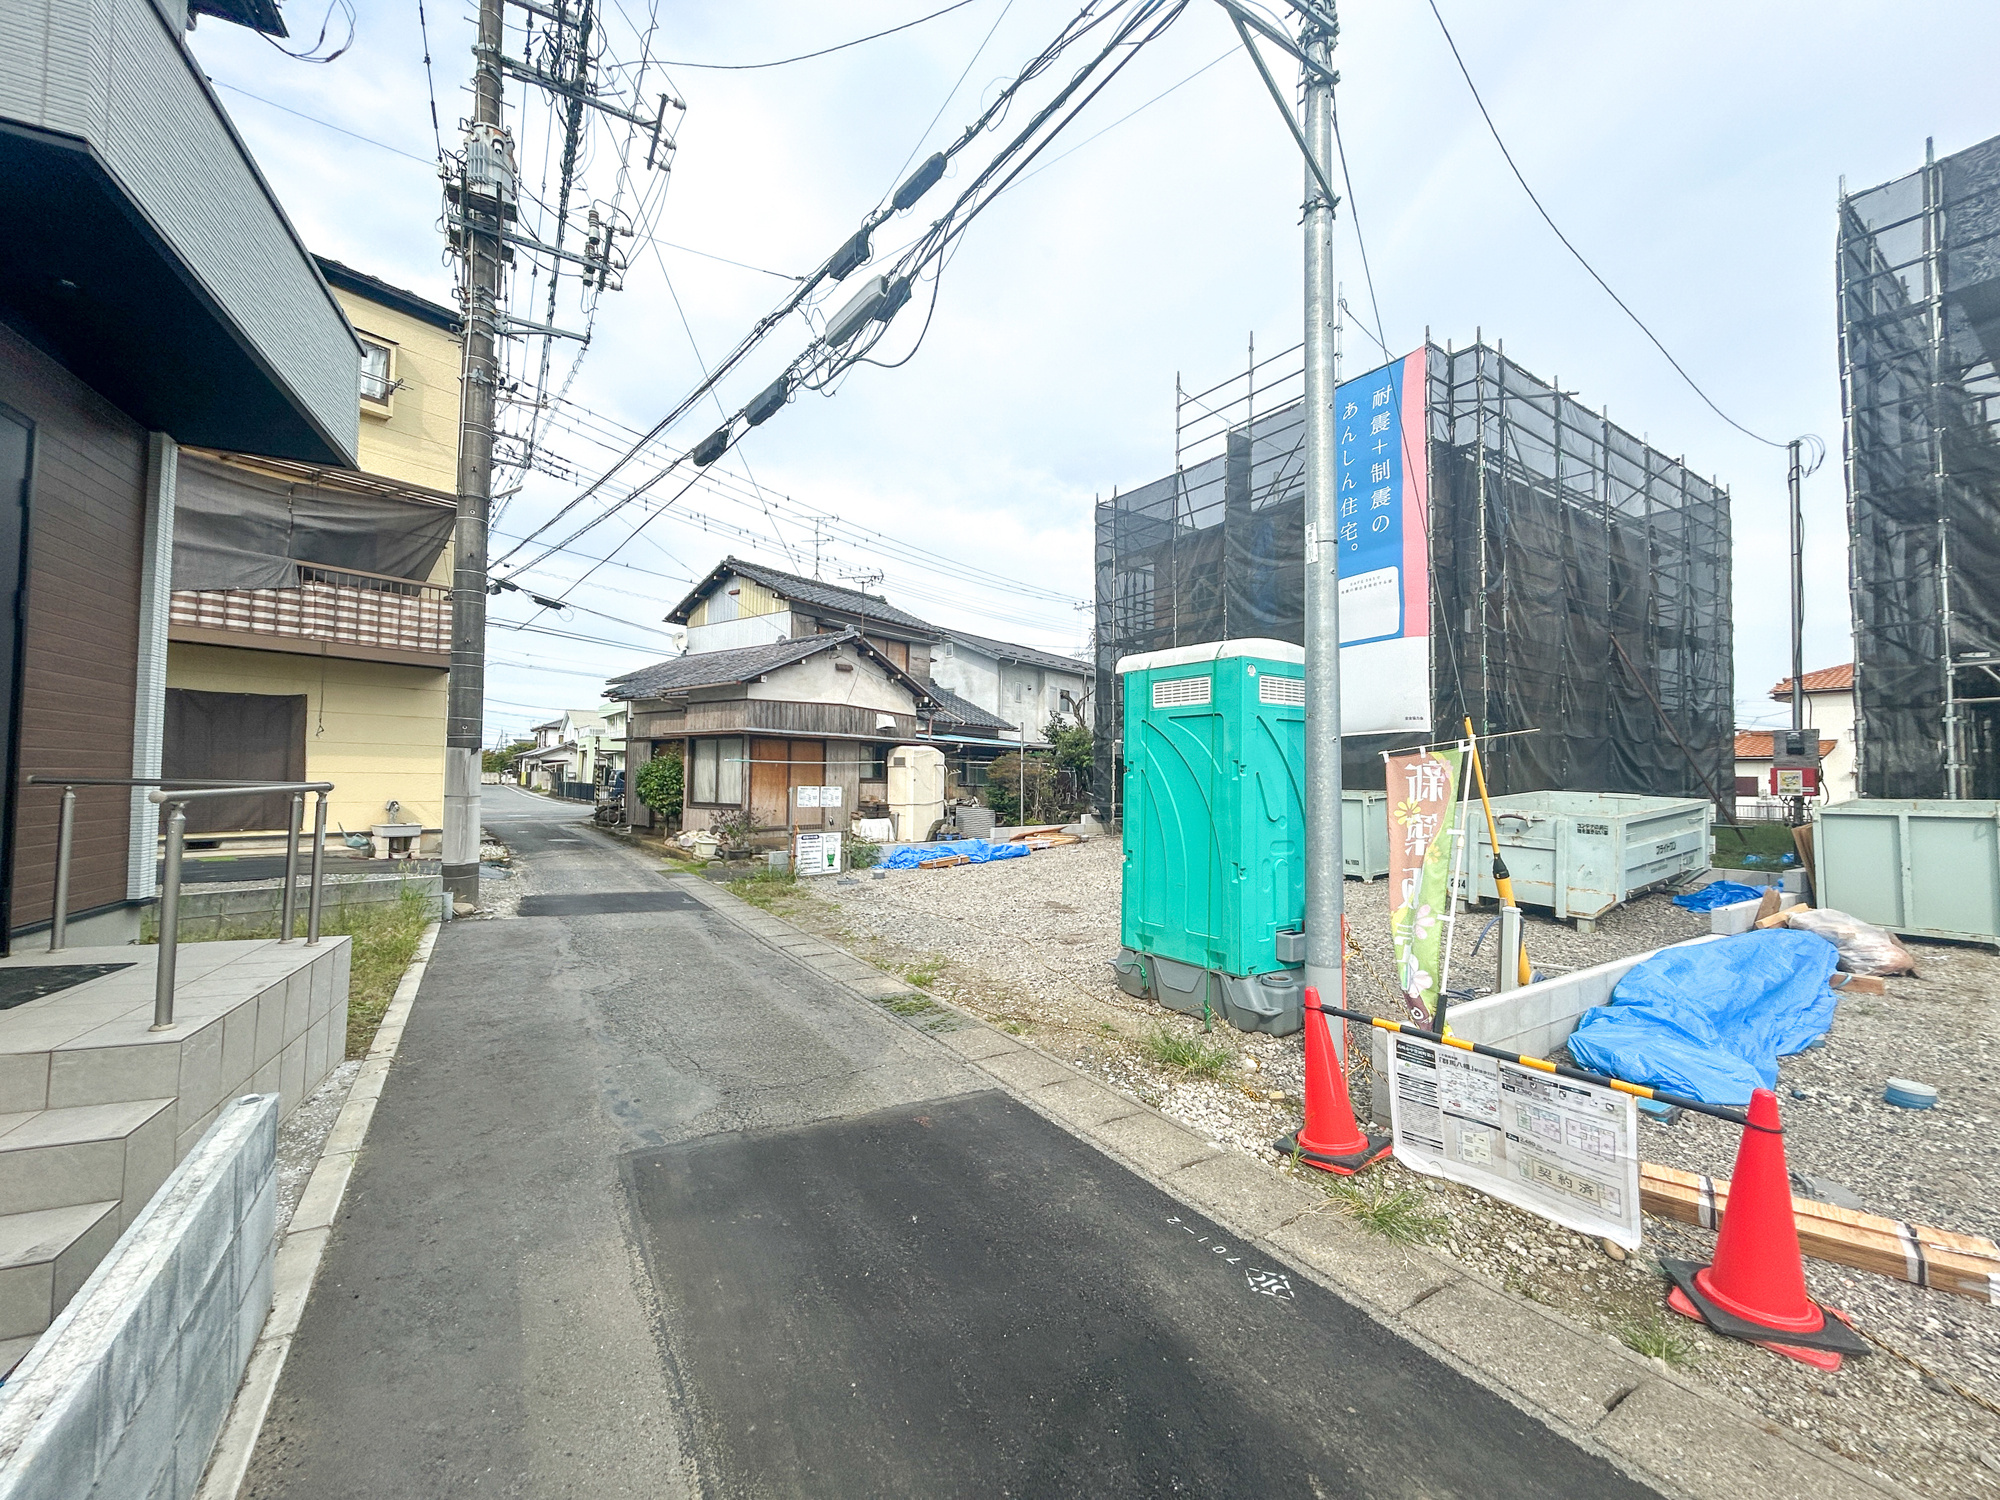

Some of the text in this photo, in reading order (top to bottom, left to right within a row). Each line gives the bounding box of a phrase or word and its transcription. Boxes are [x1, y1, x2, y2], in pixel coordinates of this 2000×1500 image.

[1340, 402, 1359, 551] あんしん住宅。
[1370, 384, 1393, 532] 耐震+制震の
[1537, 1165, 1595, 1197] 契約済
